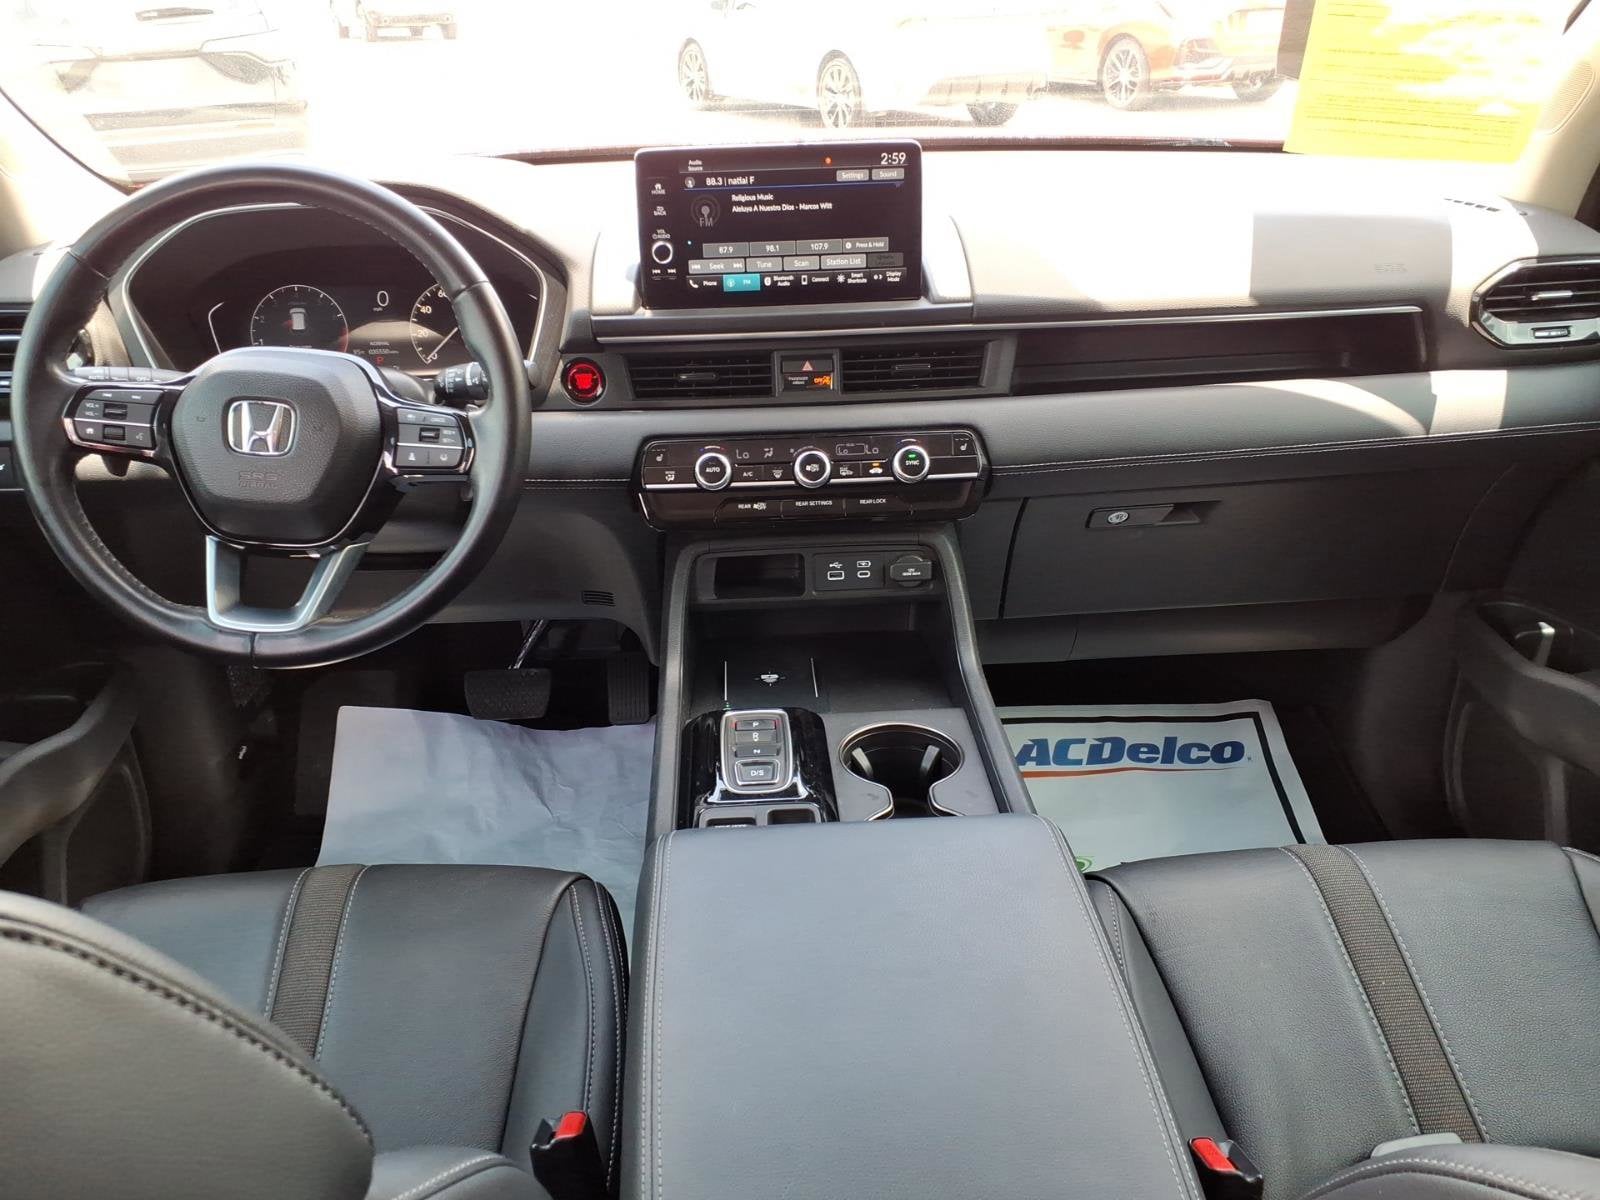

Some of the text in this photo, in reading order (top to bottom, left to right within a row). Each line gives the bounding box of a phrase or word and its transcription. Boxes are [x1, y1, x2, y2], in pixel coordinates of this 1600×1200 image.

[881, 152, 906, 165] 2:59
[842, 171, 864, 180] Settings
[880, 170, 897, 178] Sound
[706, 177, 722, 186] 88.3
[731, 193, 774, 203] Religious Music
[782, 203, 795, 211] Dios
[700, 218, 713, 227] FM
[718, 246, 734, 254] 87.9
[765, 244, 780, 252] 98.1
[709, 262, 725, 270] Seek
[756, 260, 772, 268] Tune
[793, 259, 810, 267] Scan
[826, 258, 849, 266] Station
[377, 290, 389, 307] 0
[420, 305, 432, 314] 40
[377, 356, 384, 365] P
[1016, 735, 1245, 767] ACDelco
[750, 769, 765, 777] D/S
